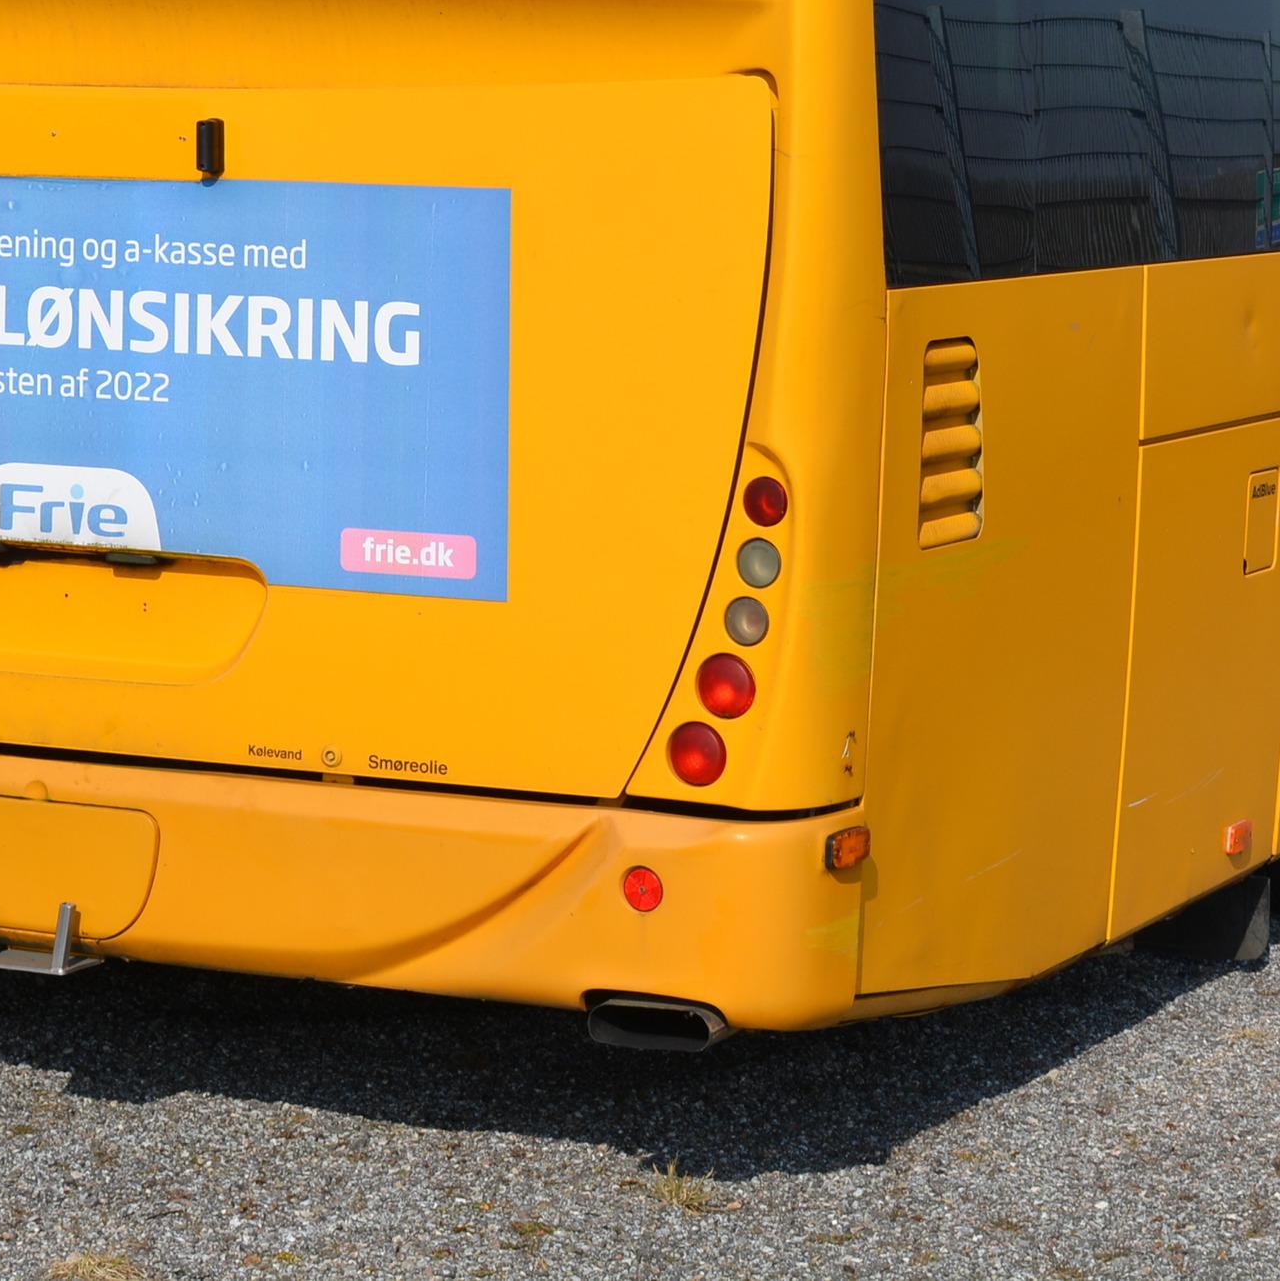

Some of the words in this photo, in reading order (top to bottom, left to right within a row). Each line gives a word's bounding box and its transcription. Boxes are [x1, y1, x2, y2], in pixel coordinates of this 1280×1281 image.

[83, 236, 117, 268] og
[124, 233, 236, 267] a-kasse
[243, 238, 307, 270] med
[59, 367, 89, 397] af
[95, 369, 170, 403] 2022
[1251, 482, 1277, 499] AdBlue
[362, 536, 454, 568] frie.dk
[248, 744, 303, 761] Kølevand
[368, 754, 449, 776] Smøreolie
